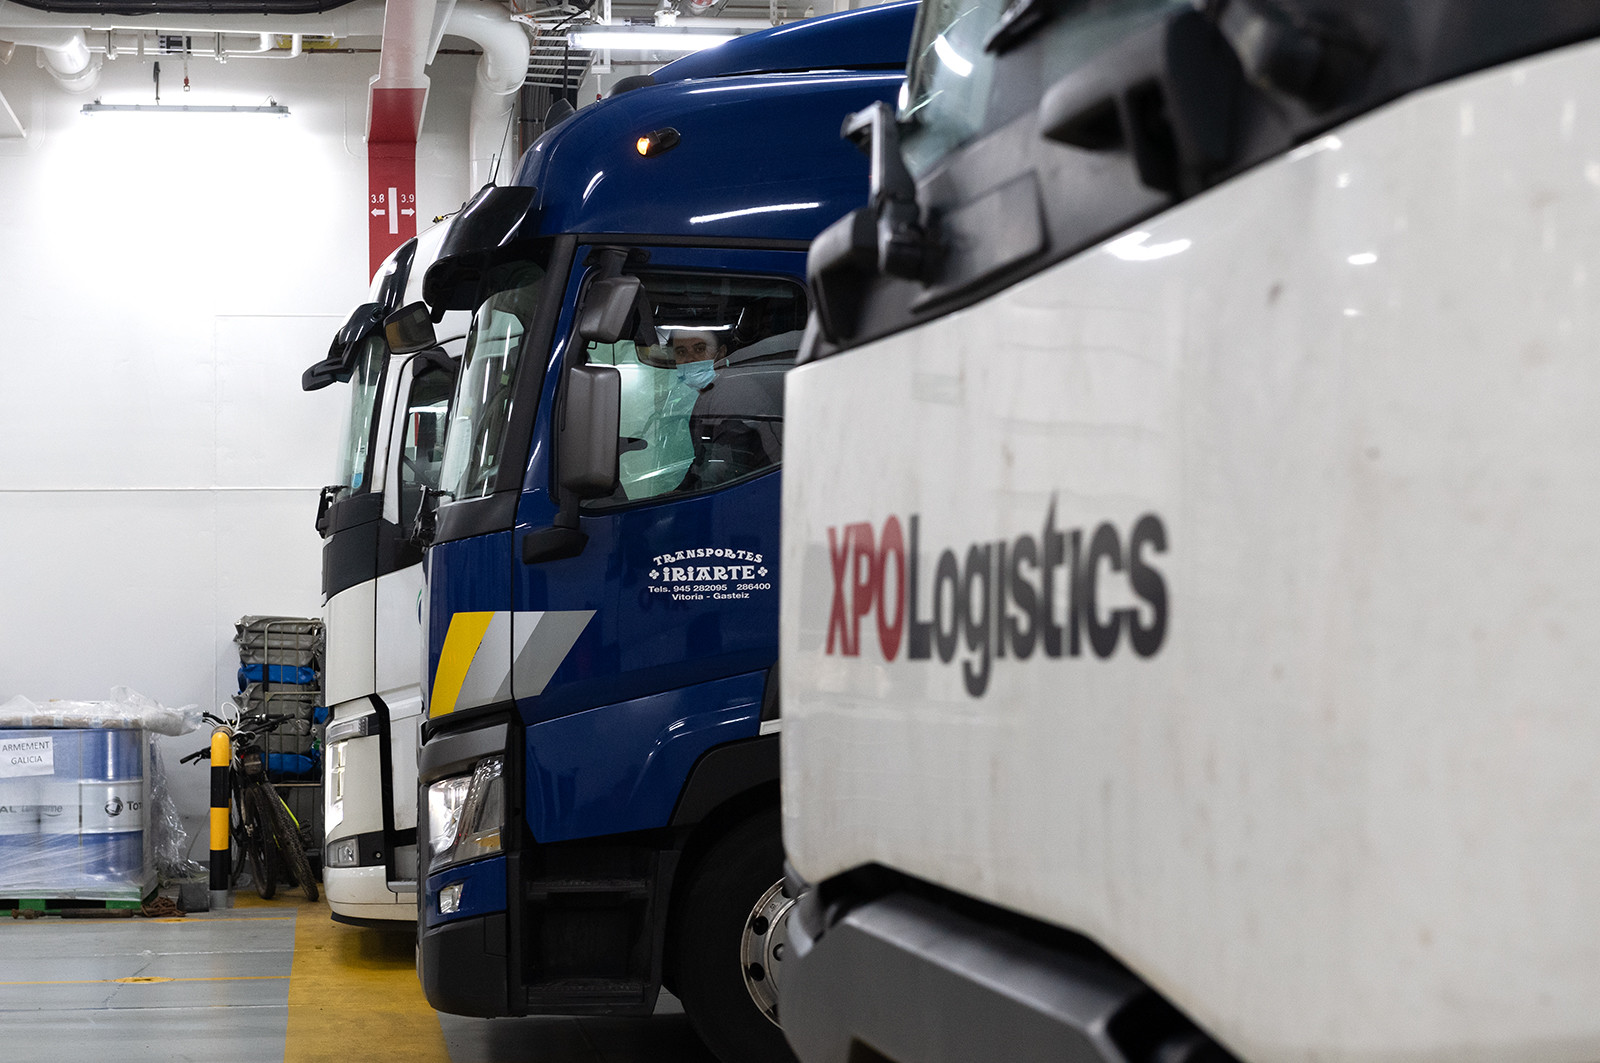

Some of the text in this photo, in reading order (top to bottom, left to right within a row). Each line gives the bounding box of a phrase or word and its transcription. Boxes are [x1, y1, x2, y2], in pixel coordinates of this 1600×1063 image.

[371, 193, 385, 204] 3.8
[401, 193, 415, 204] 3.9
[653, 548, 763, 566] TRANSPORTES
[648, 583, 771, 594] Tels. 945 282095 286400
[672, 593, 704, 601] Vitoria
[713, 592, 750, 600] Gasteiz
[2, 741, 50, 752] ARMEMENT
[11, 755, 43, 765] GALICIA
